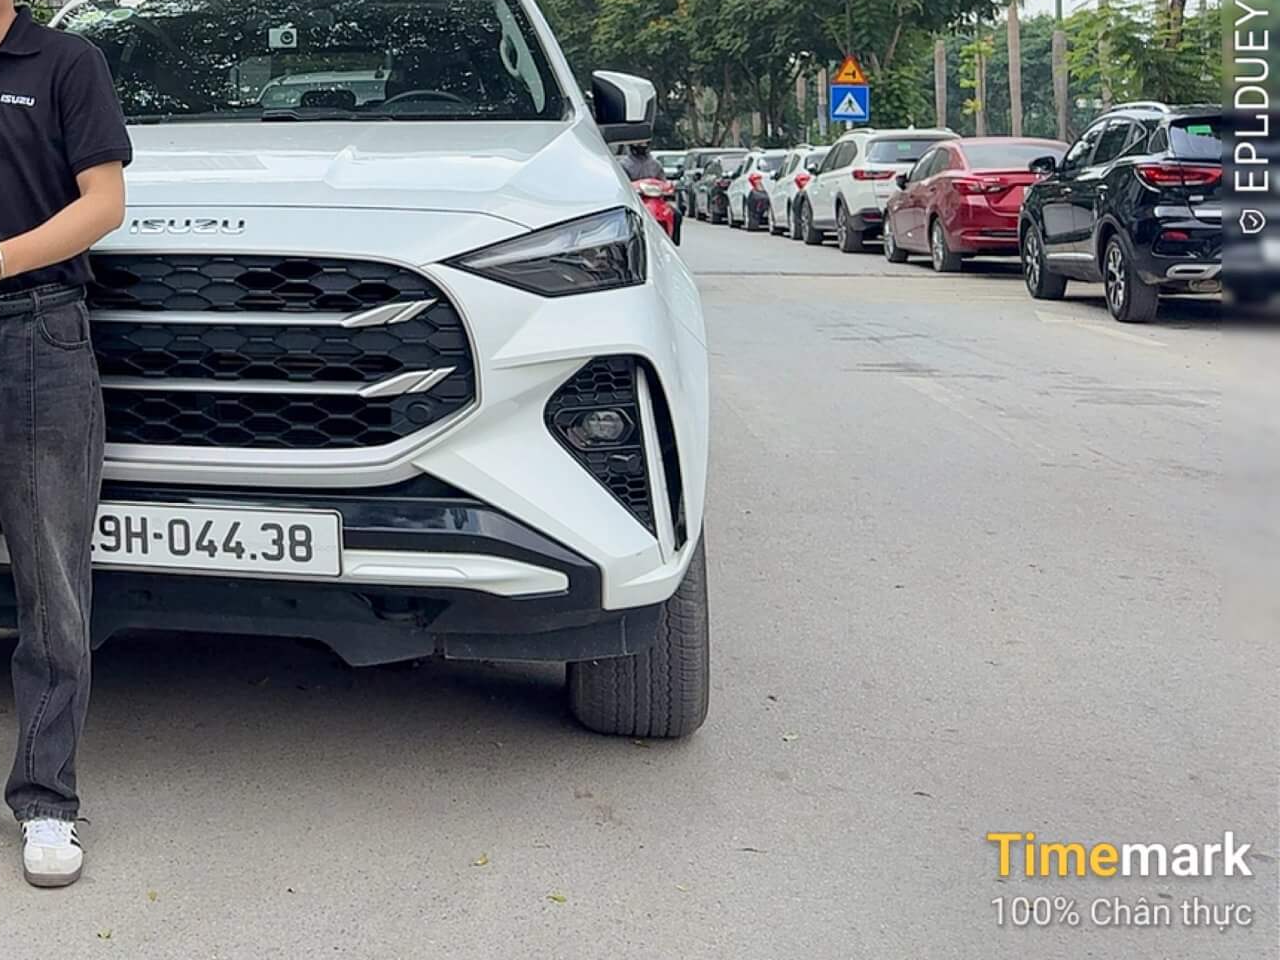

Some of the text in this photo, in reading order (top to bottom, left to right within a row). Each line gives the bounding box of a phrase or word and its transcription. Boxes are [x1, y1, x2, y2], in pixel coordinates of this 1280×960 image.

[0, 93, 36, 107] ISUZU
[130, 218, 246, 235] ISUZU
[91, 514, 314, 563] 9H-044.38
